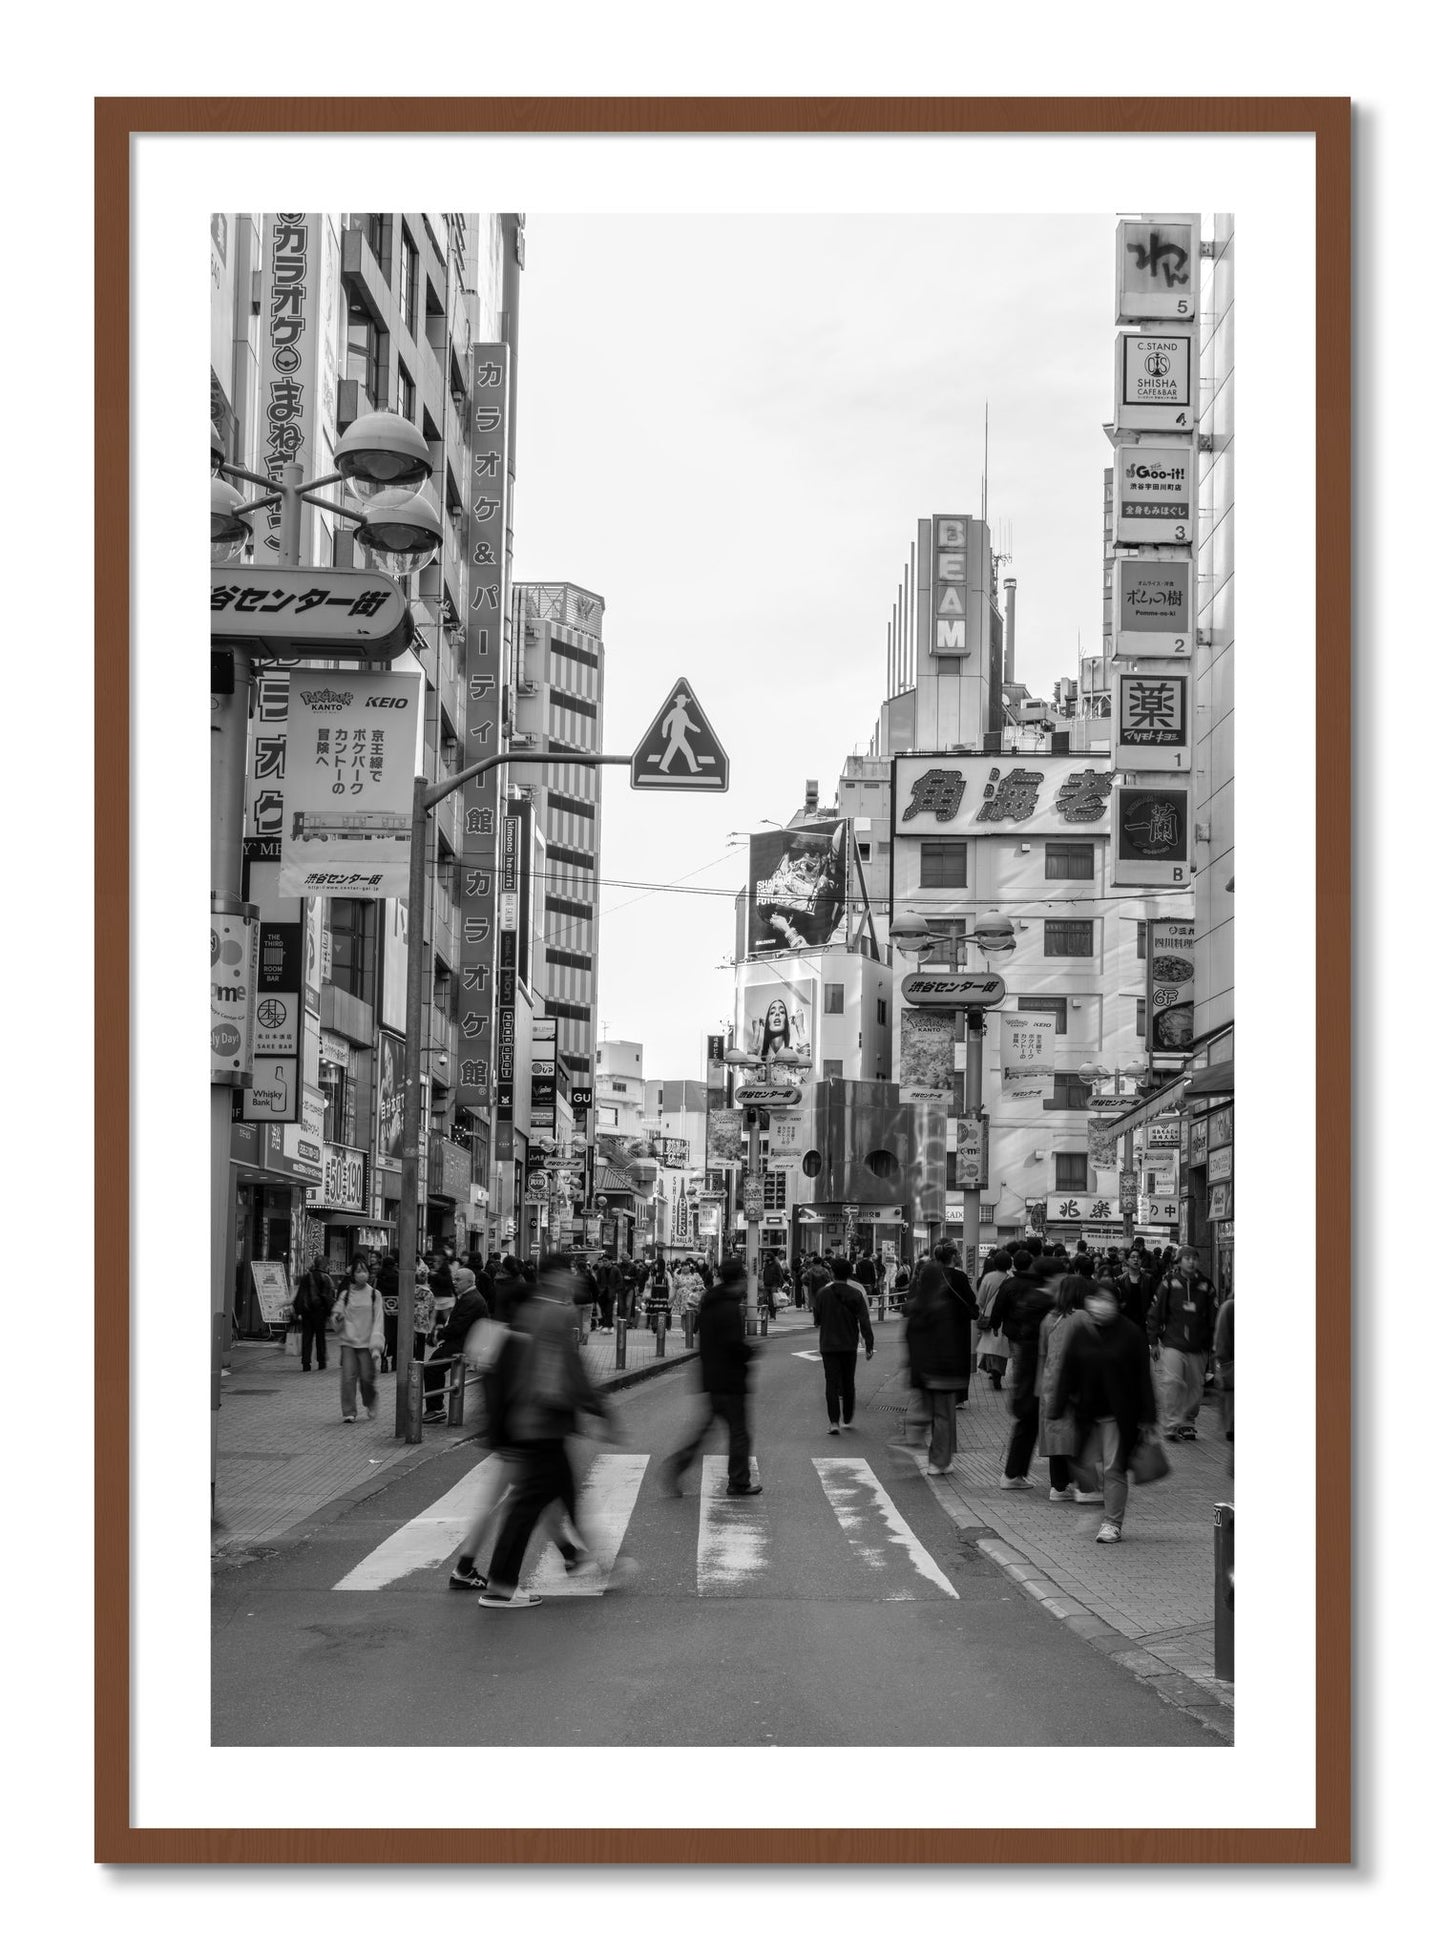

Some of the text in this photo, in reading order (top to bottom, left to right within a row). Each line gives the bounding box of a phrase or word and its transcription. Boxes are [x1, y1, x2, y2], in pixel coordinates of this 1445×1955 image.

[270, 224, 306, 346] カラオケ
[1177, 300, 1188, 313] 5
[1137, 342, 1178, 351] C.STAND
[1137, 378, 1177, 388] SHISHA
[1136, 465, 1185, 480] Goo-it!
[1125, 505, 1186, 516] 全身もみほぐし
[1175, 525, 1186, 540] 3
[936, 520, 967, 649] BEAM
[1126, 589, 1184, 607] ポムの樹
[1174, 639, 1185, 653] 2
[311, 703, 343, 711] KANTO
[365, 696, 409, 709] KEIO
[1129, 682, 1175, 728] 薬
[316, 728, 331, 767] 冒険へ
[332, 729, 348, 795] カントーの
[369, 729, 385, 783] 京王線で
[1174, 752, 1181, 767] 1
[901, 767, 1115, 823] 角海老
[505, 821, 514, 888] kimono hearts
[304, 873, 384, 886] 渋谷センター街
[1173, 867, 1183, 881] B
[907, 981, 1000, 993] 渋谷センター街
[1153, 988, 1179, 1007] 6F
[221, 1032, 240, 1046] Day!
[252, 1090, 283, 1100] Whisky
[573, 1093, 592, 1103] GU
